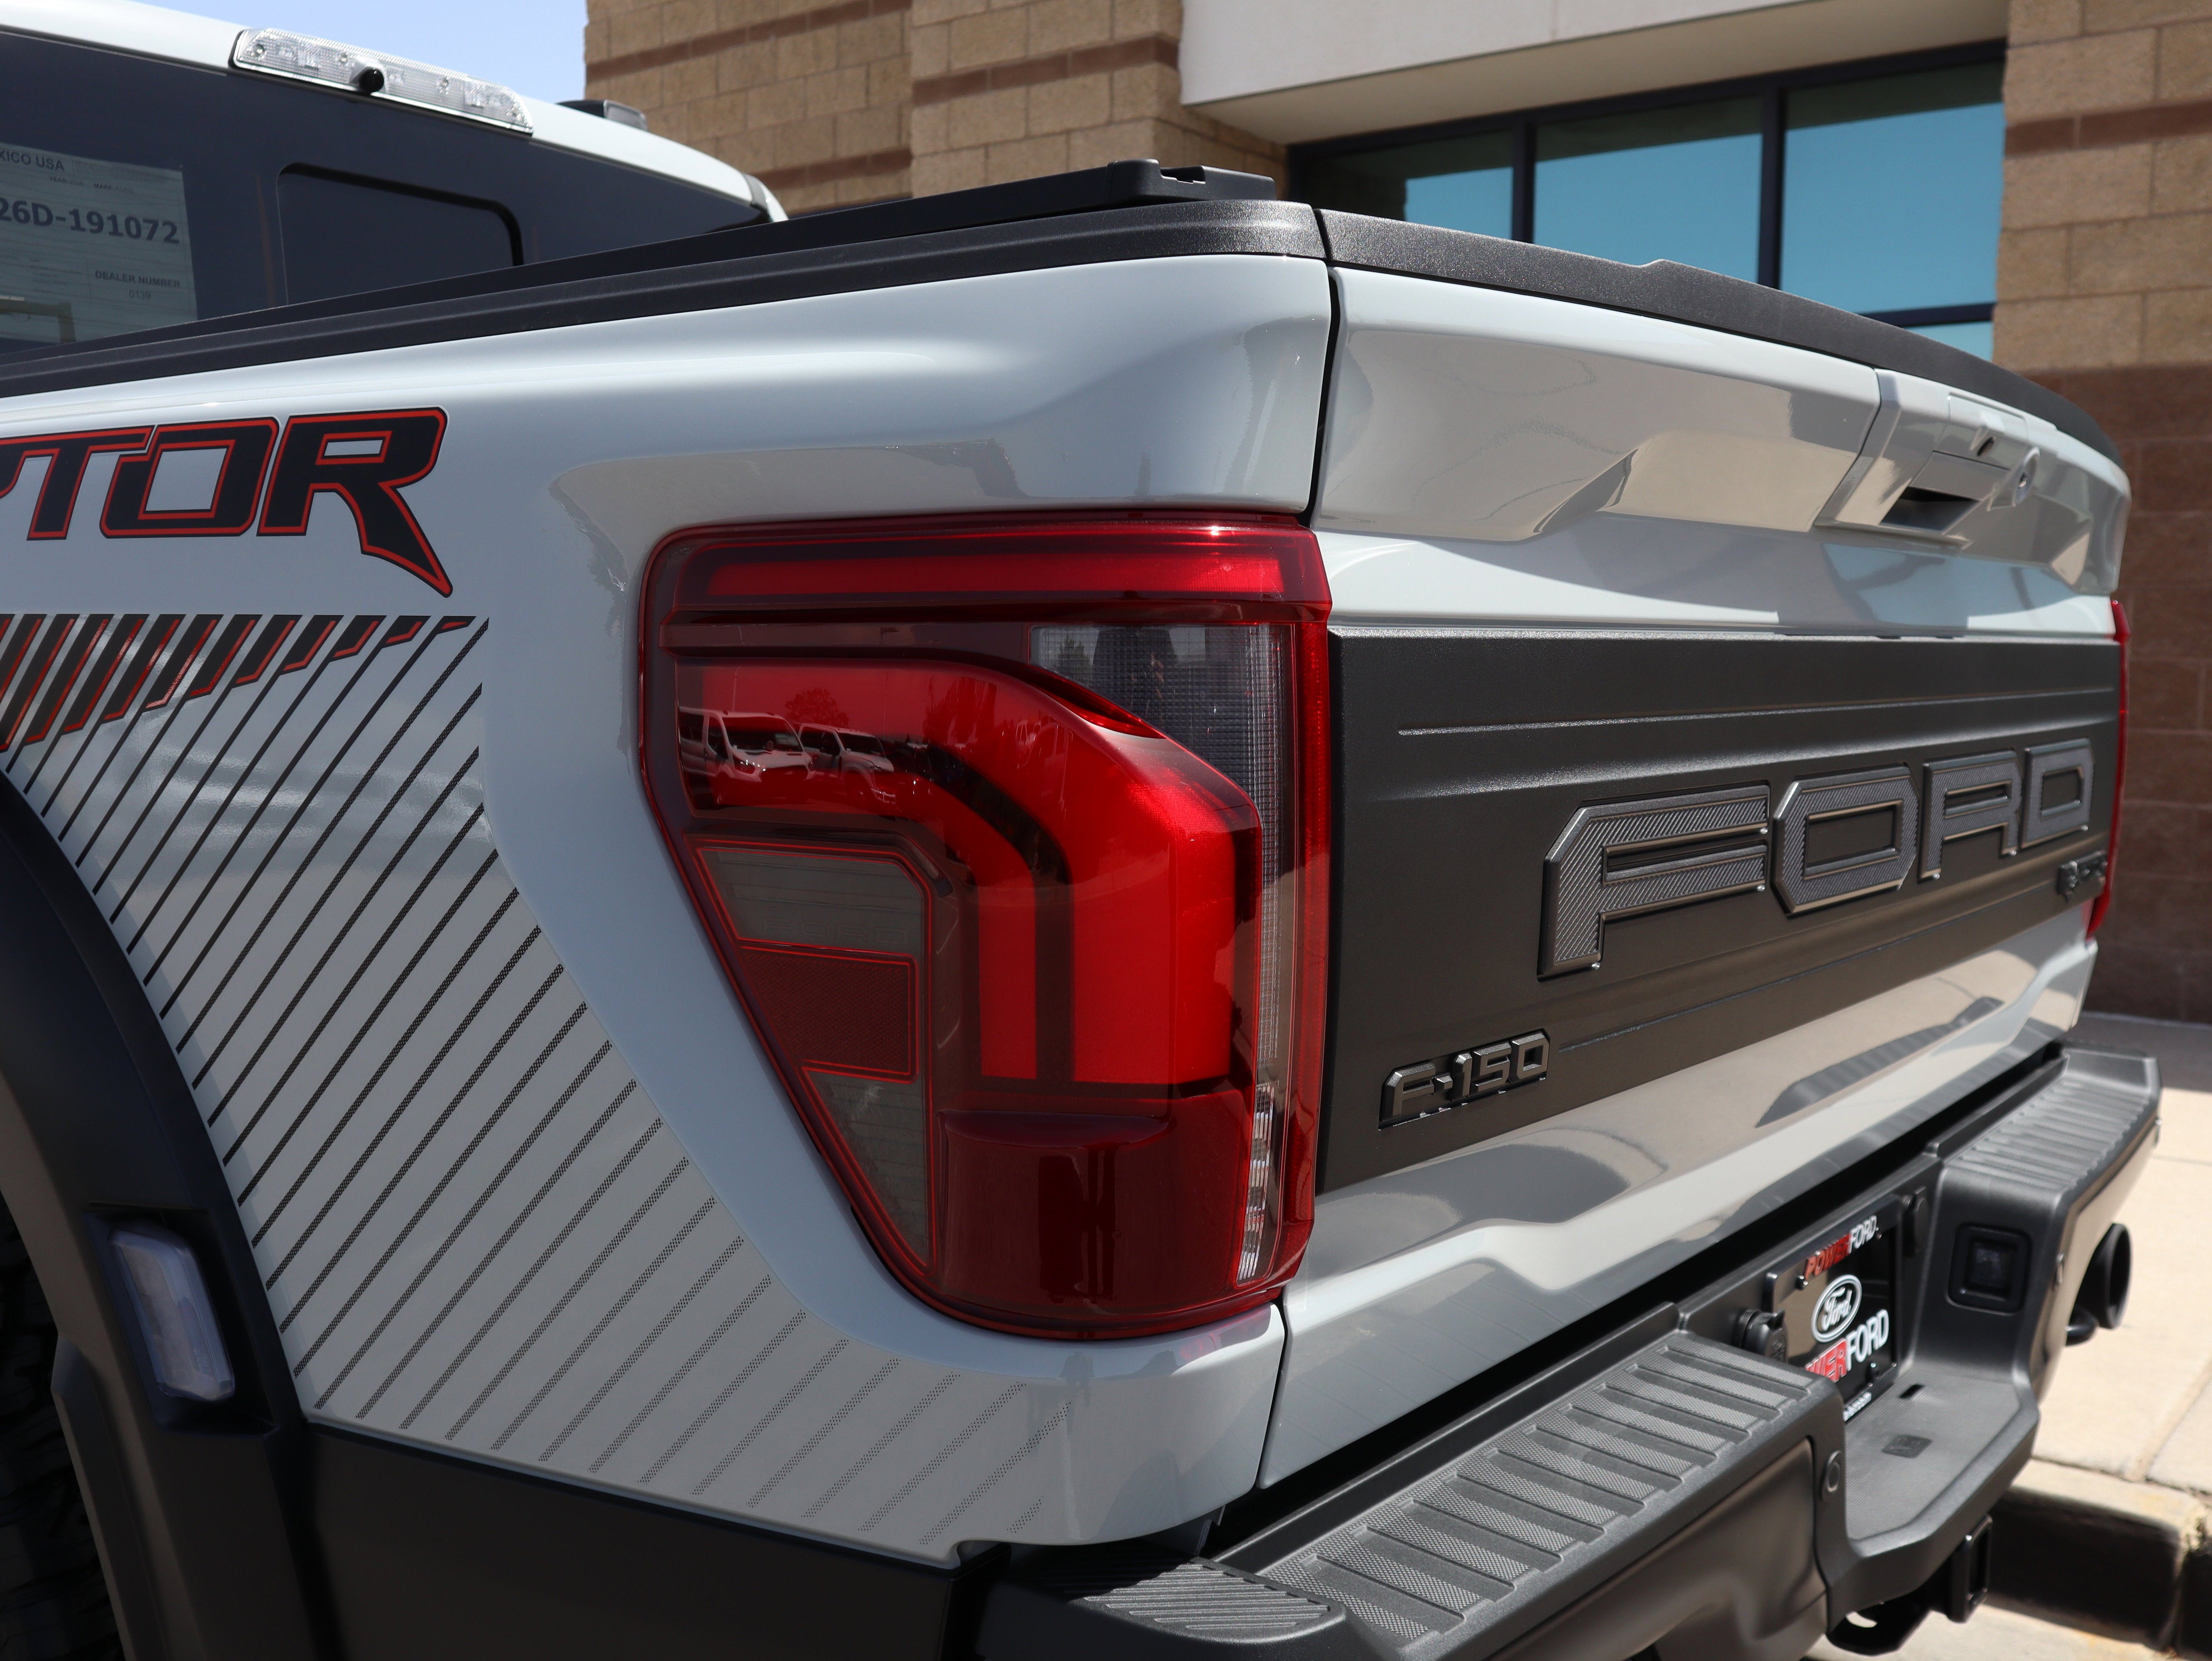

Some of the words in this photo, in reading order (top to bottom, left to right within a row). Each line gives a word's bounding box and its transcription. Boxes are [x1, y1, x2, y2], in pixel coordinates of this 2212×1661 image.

[35, 155, 65, 171] USA
[0, 197, 179, 244] 26D-191072
[95, 270, 136, 283] DEALER
[138, 276, 181, 288] NUMBER
[0, 407, 453, 598] TOR
[1538, 737, 2095, 979] FORD
[763, 916, 911, 945] FORD
[1380, 1029, 1550, 1123] F-150
[1821, 1286, 1852, 1331] Ford
